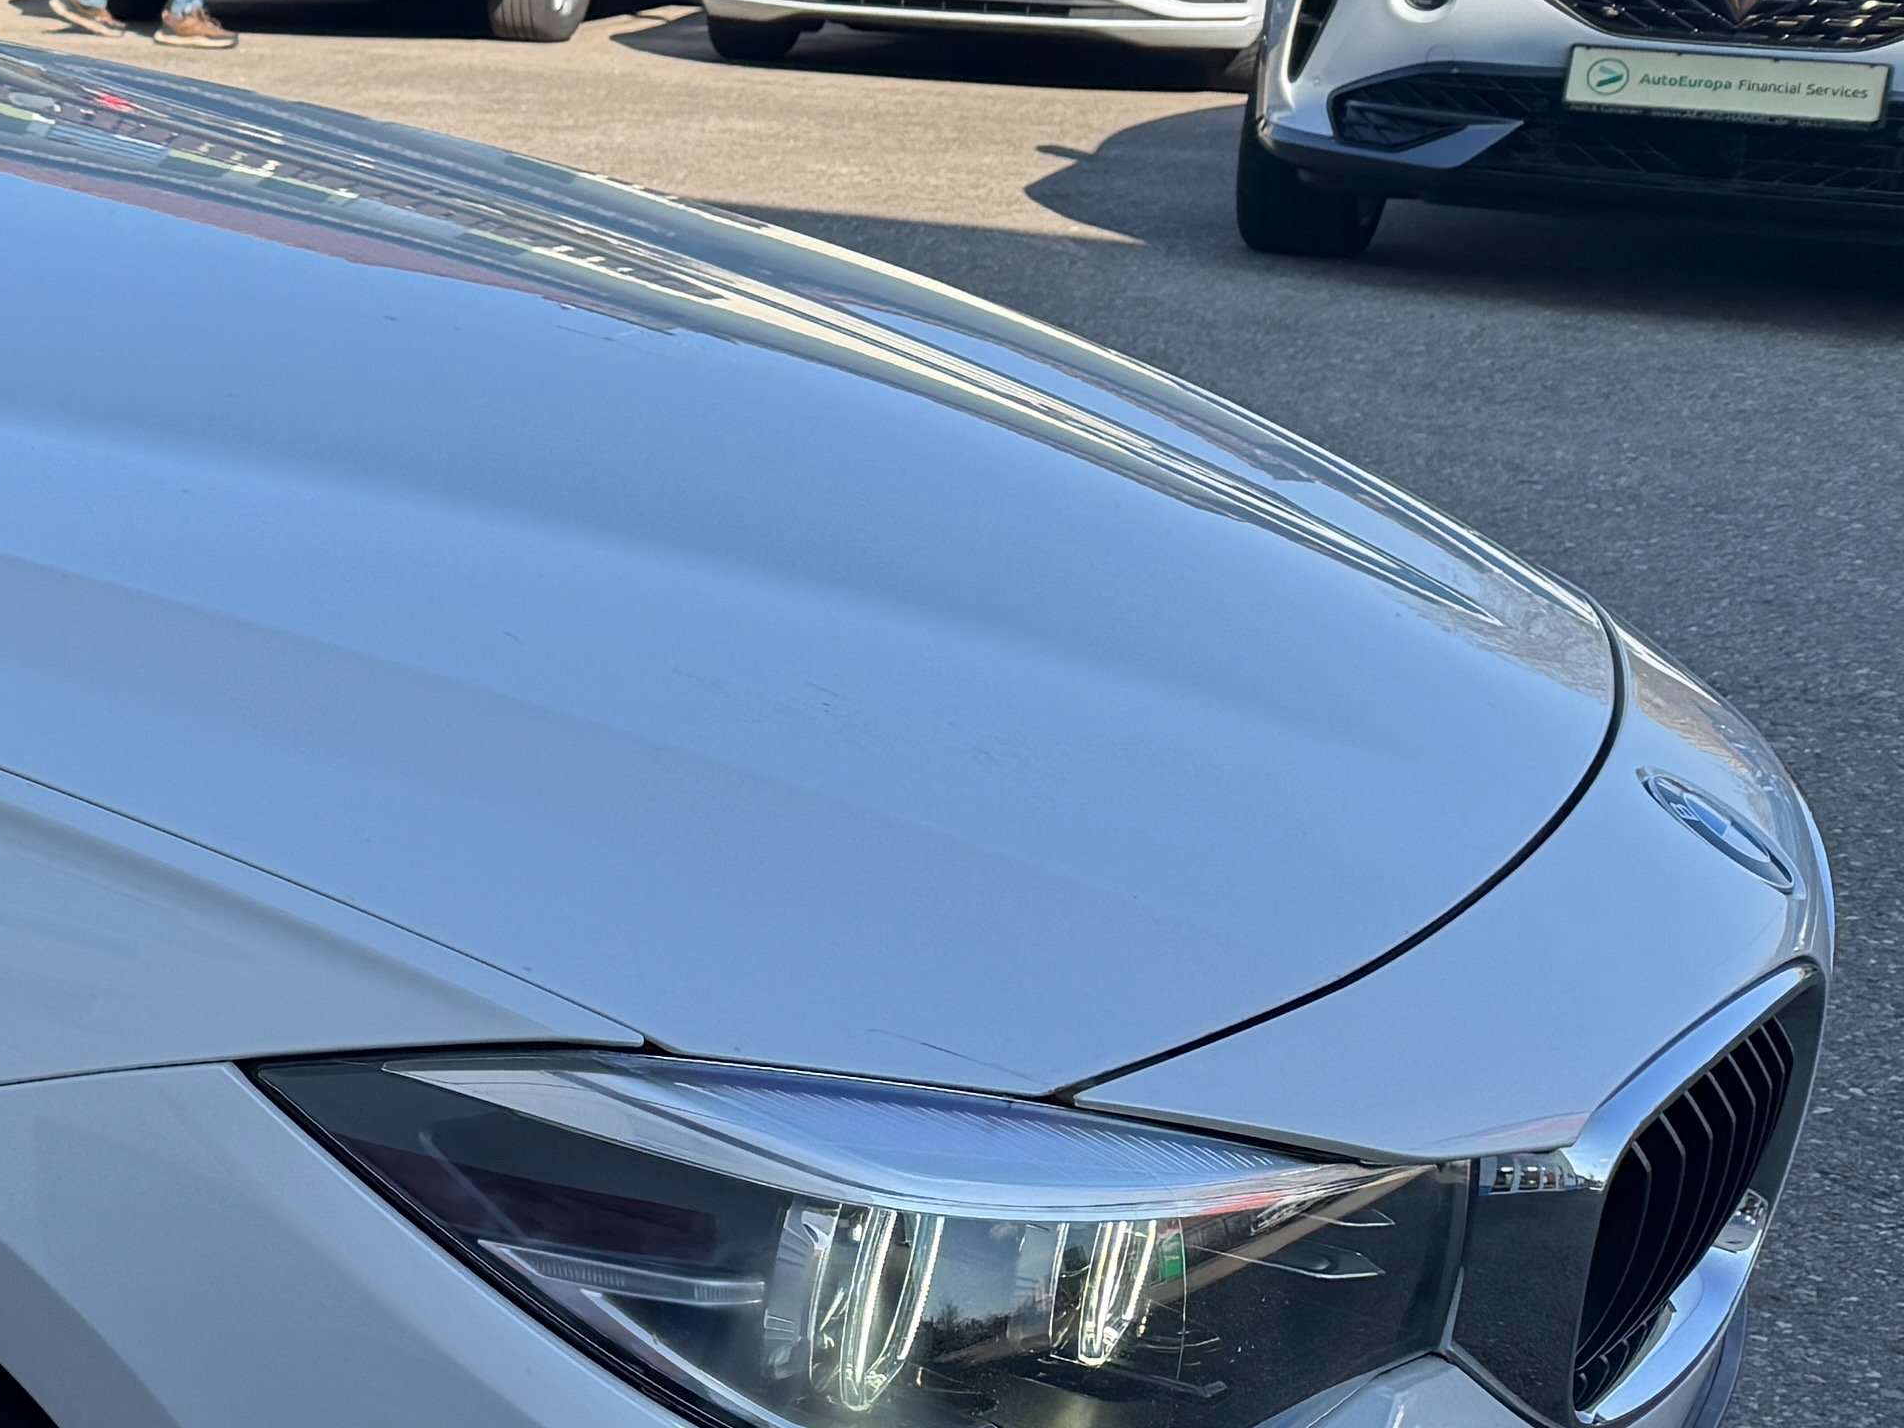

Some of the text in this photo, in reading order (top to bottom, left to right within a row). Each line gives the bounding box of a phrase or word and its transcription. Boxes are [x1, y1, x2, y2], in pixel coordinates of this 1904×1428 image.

[1639, 72, 1869, 100] AutoEuropa Financial Services
